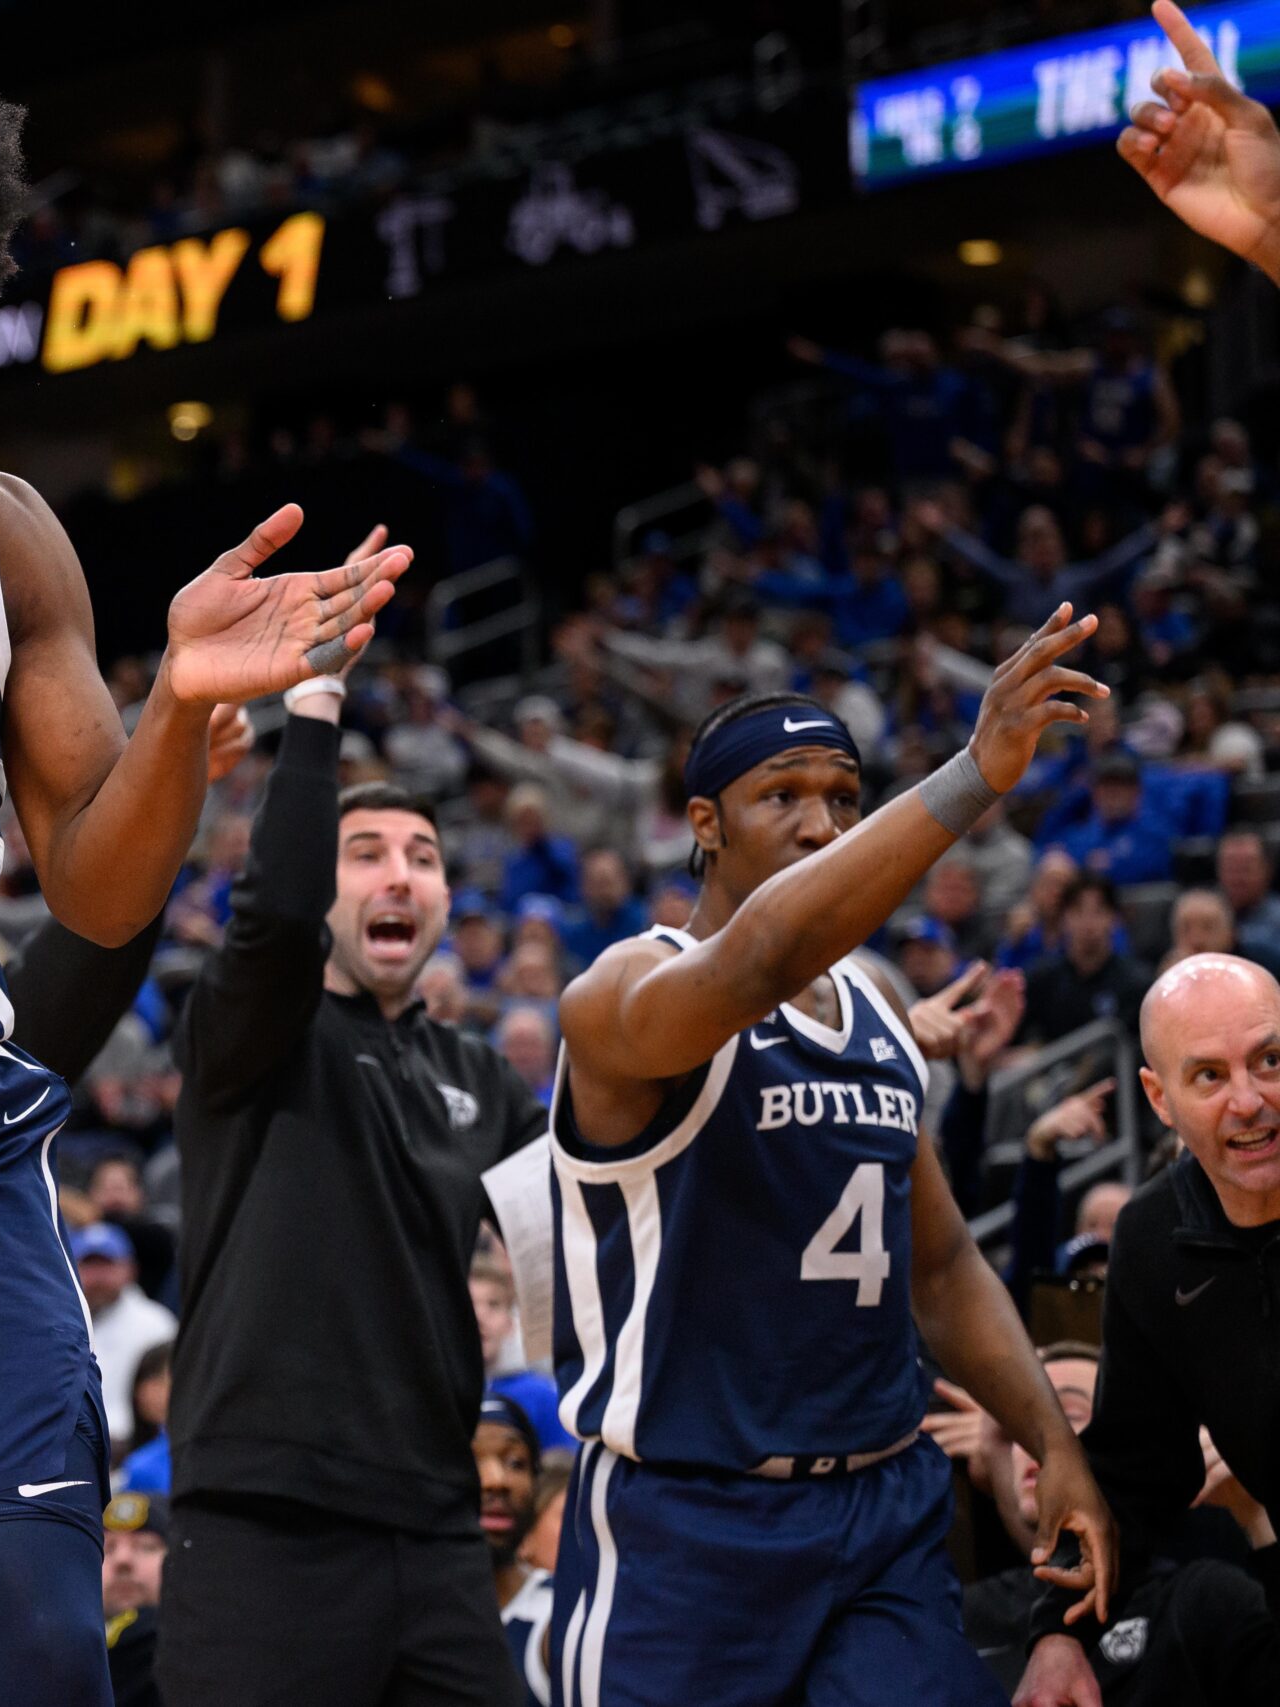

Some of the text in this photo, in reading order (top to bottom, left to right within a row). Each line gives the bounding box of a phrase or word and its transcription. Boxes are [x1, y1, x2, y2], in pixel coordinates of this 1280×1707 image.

[41, 227, 251, 375] DAY
[259, 211, 325, 322] 1
[757, 1081, 919, 1138] BUTLER
[800, 1162, 890, 1307] 4
